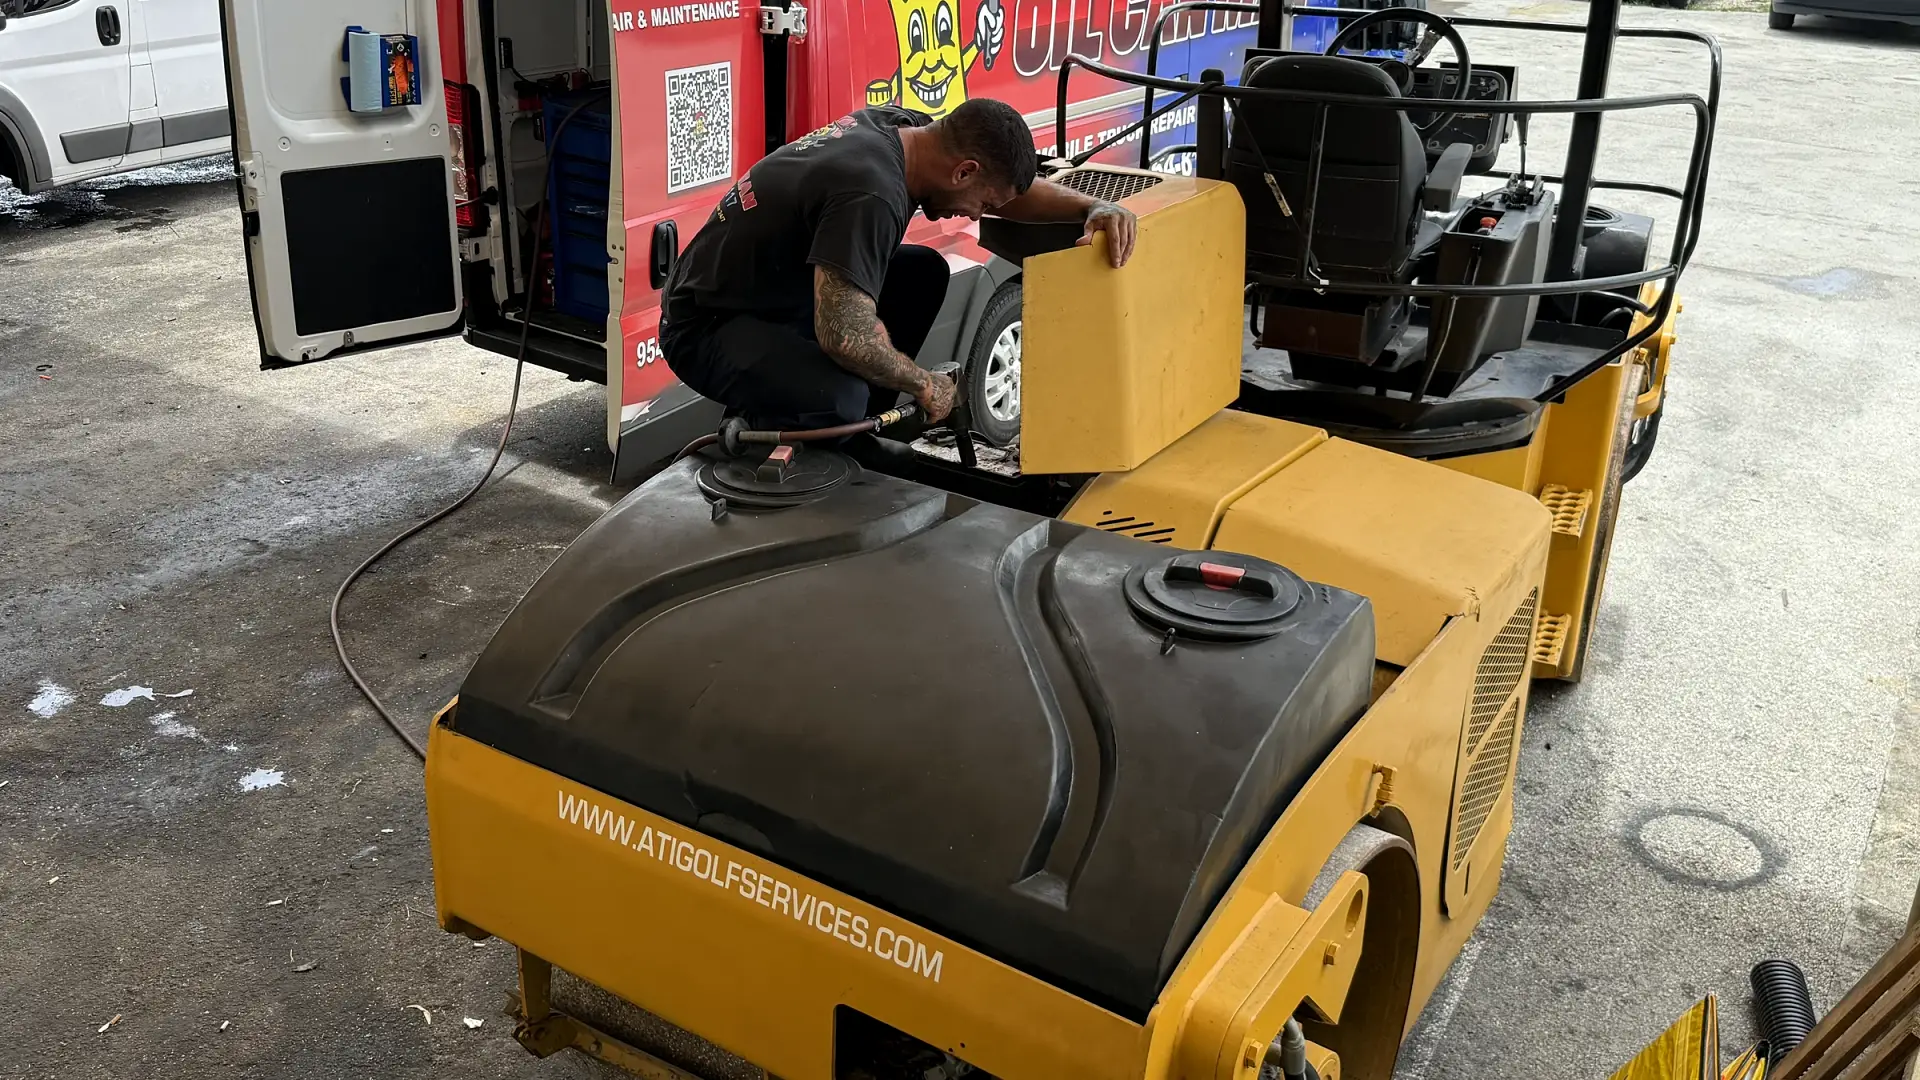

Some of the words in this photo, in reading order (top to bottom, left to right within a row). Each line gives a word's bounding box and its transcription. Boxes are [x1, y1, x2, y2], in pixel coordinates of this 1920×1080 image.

[638, 10, 647, 29] &
[651, 0, 740, 27] MAINTENANCE
[1013, 0, 1103, 77] OIL
[1035, 134, 1094, 160] OILE
[1150, 105, 1196, 136] REPAIR
[557, 790, 944, 983] WWW.ATIGOLFSERVICES.COM
